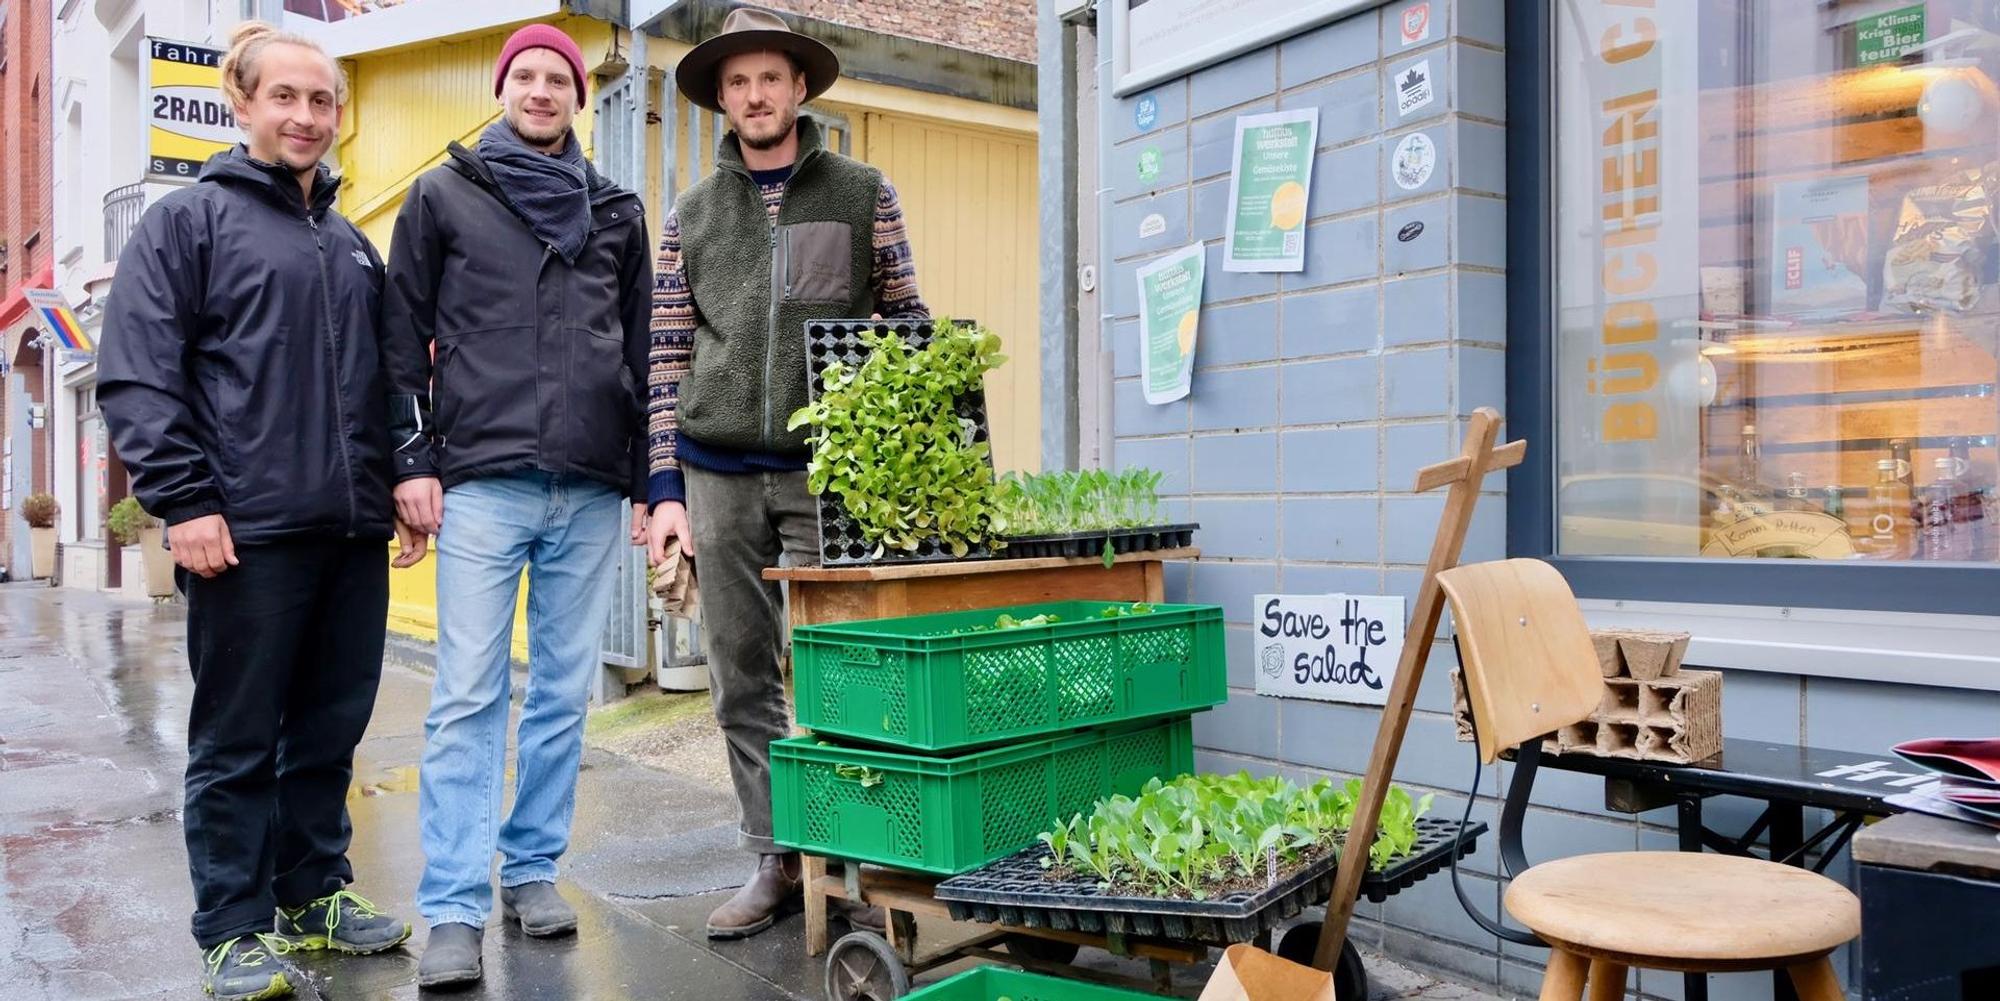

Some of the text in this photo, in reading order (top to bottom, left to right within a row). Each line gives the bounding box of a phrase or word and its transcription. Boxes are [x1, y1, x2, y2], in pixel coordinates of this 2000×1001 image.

[1859, 28, 1891, 40] Krise
[1878, 14, 1921, 28] Klima-
[1883, 33, 1920, 48] Bier
[153, 94, 238, 128] 2RADH
[1588, 0, 1659, 442] BÜDCHEN C
[1787, 249, 1801, 279] CLIF
[1261, 598, 1386, 646] Save the
[1294, 644, 1383, 690] salad
